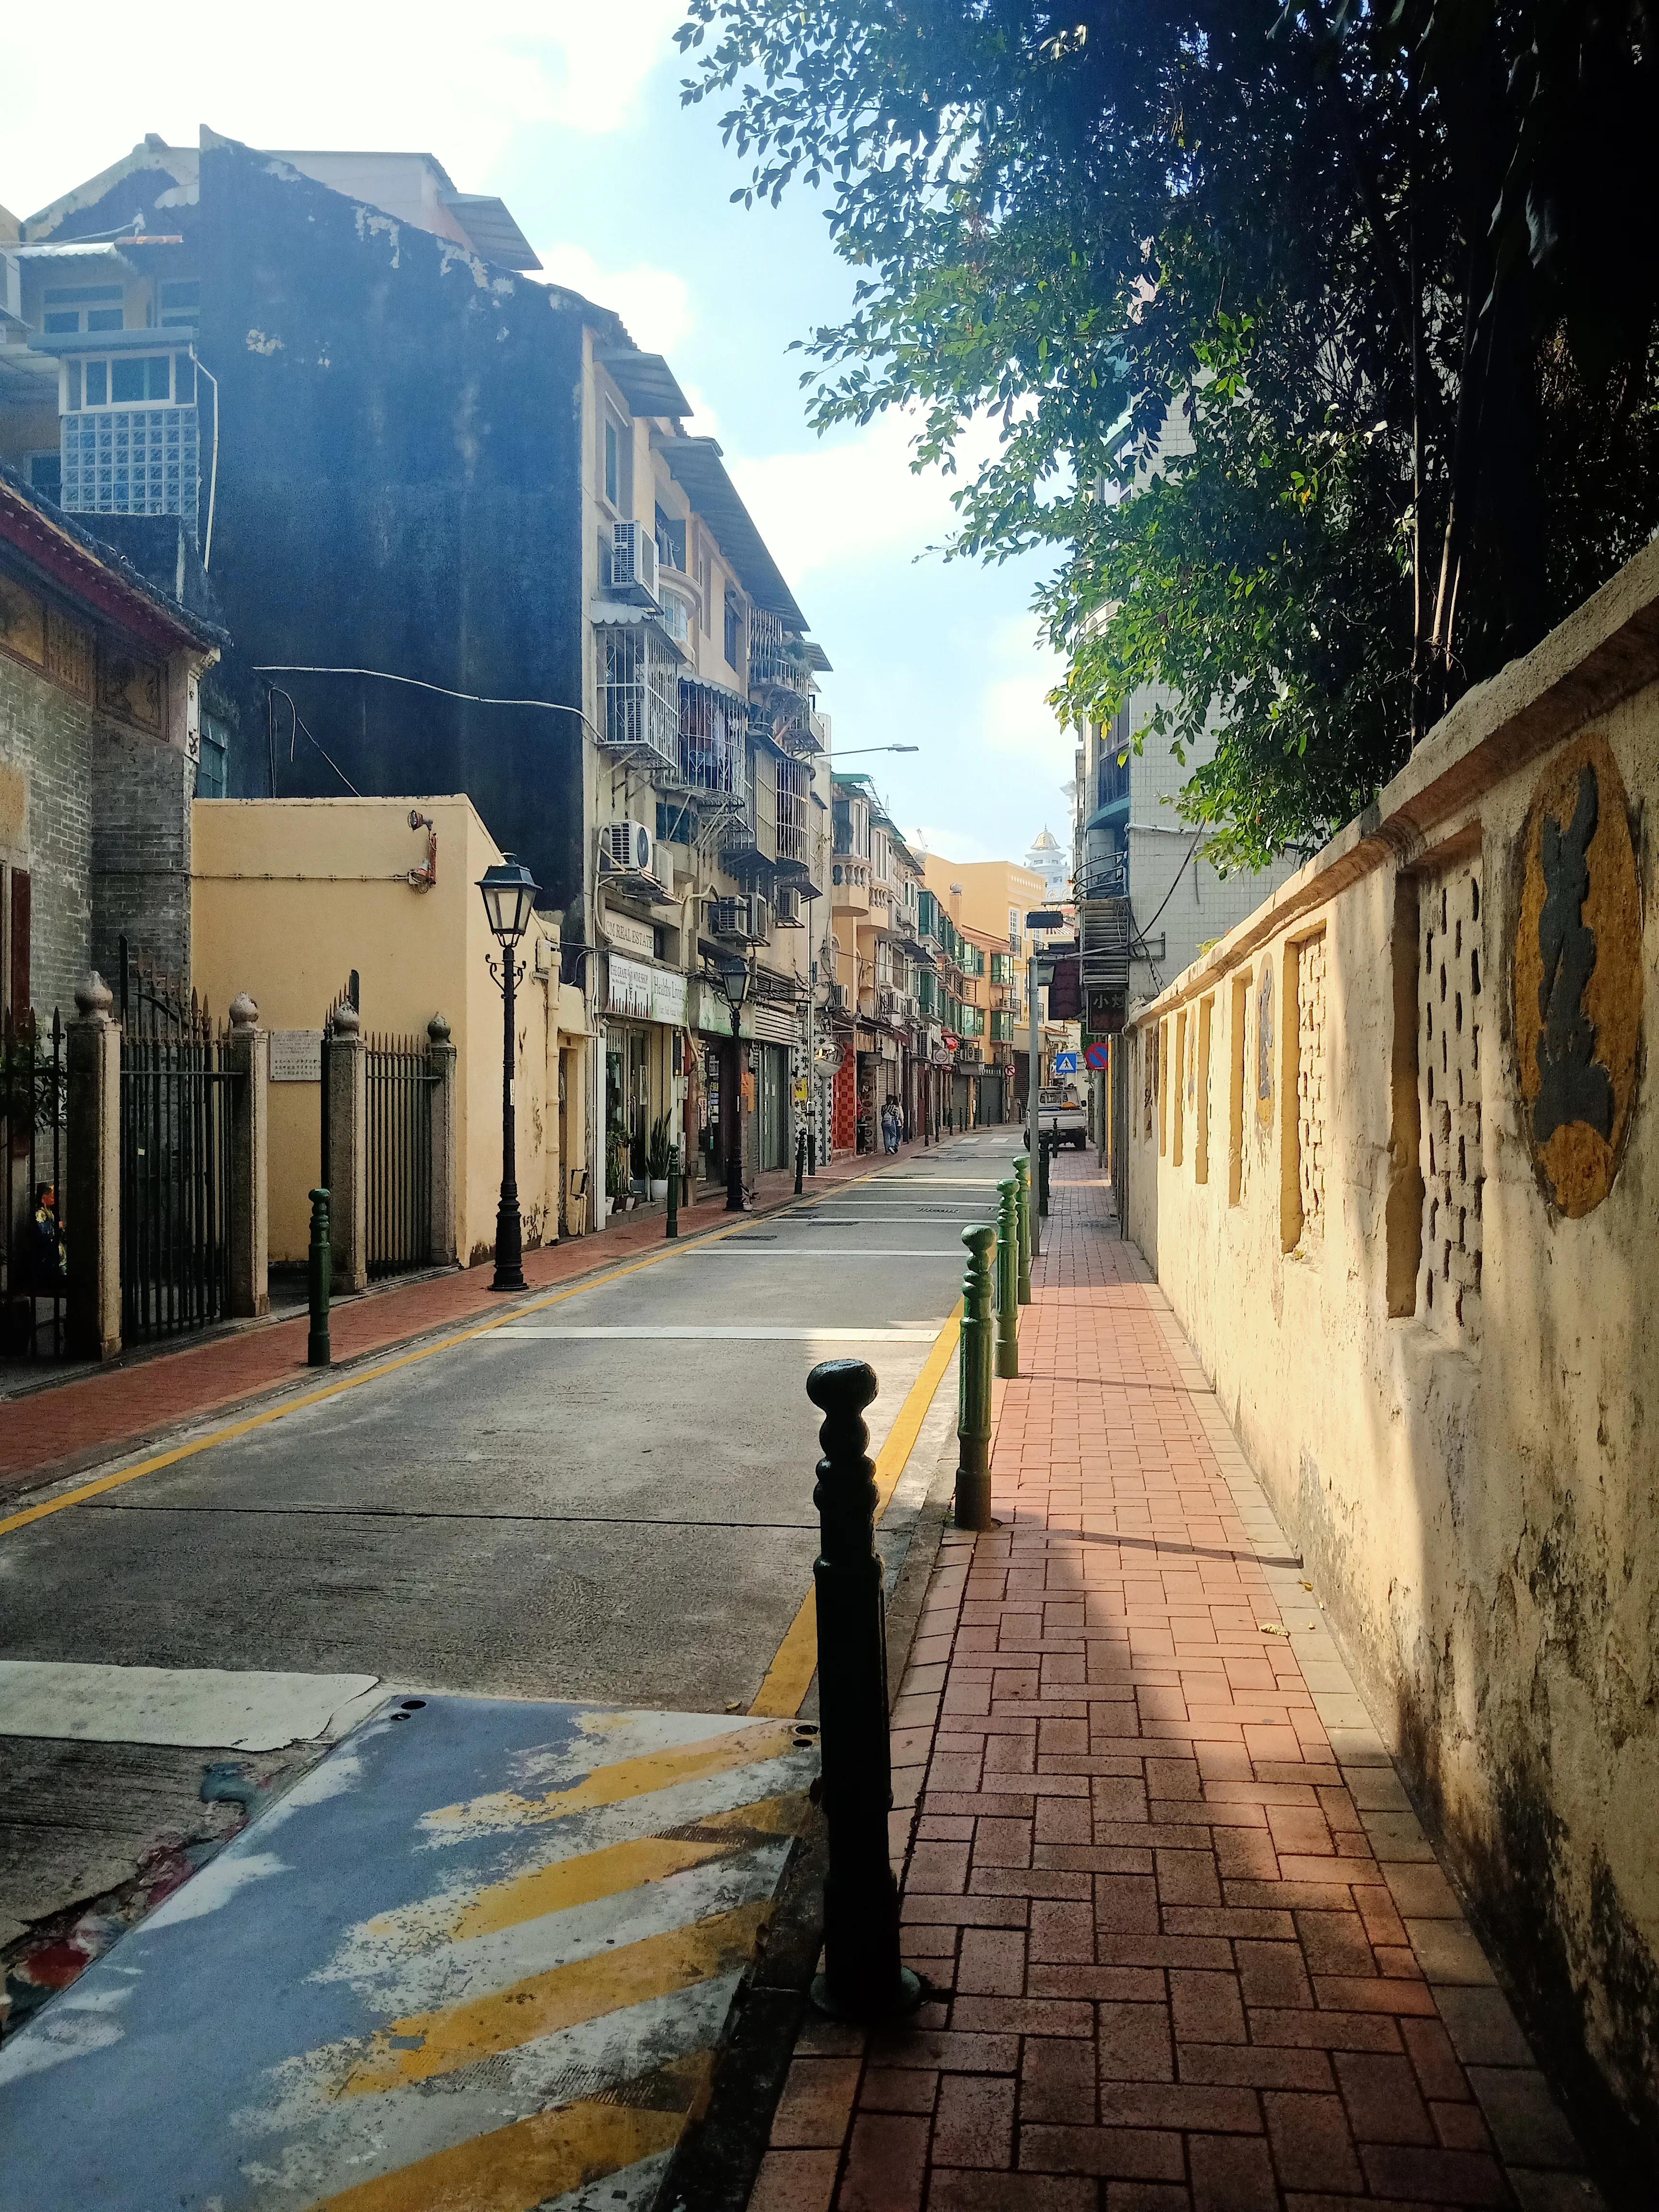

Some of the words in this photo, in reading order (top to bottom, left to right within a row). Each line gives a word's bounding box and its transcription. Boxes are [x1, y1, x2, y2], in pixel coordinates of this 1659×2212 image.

[616, 924, 631, 942] REAL
[632, 930, 653, 949] ESTATE
[654, 976, 671, 1002] Healthy
